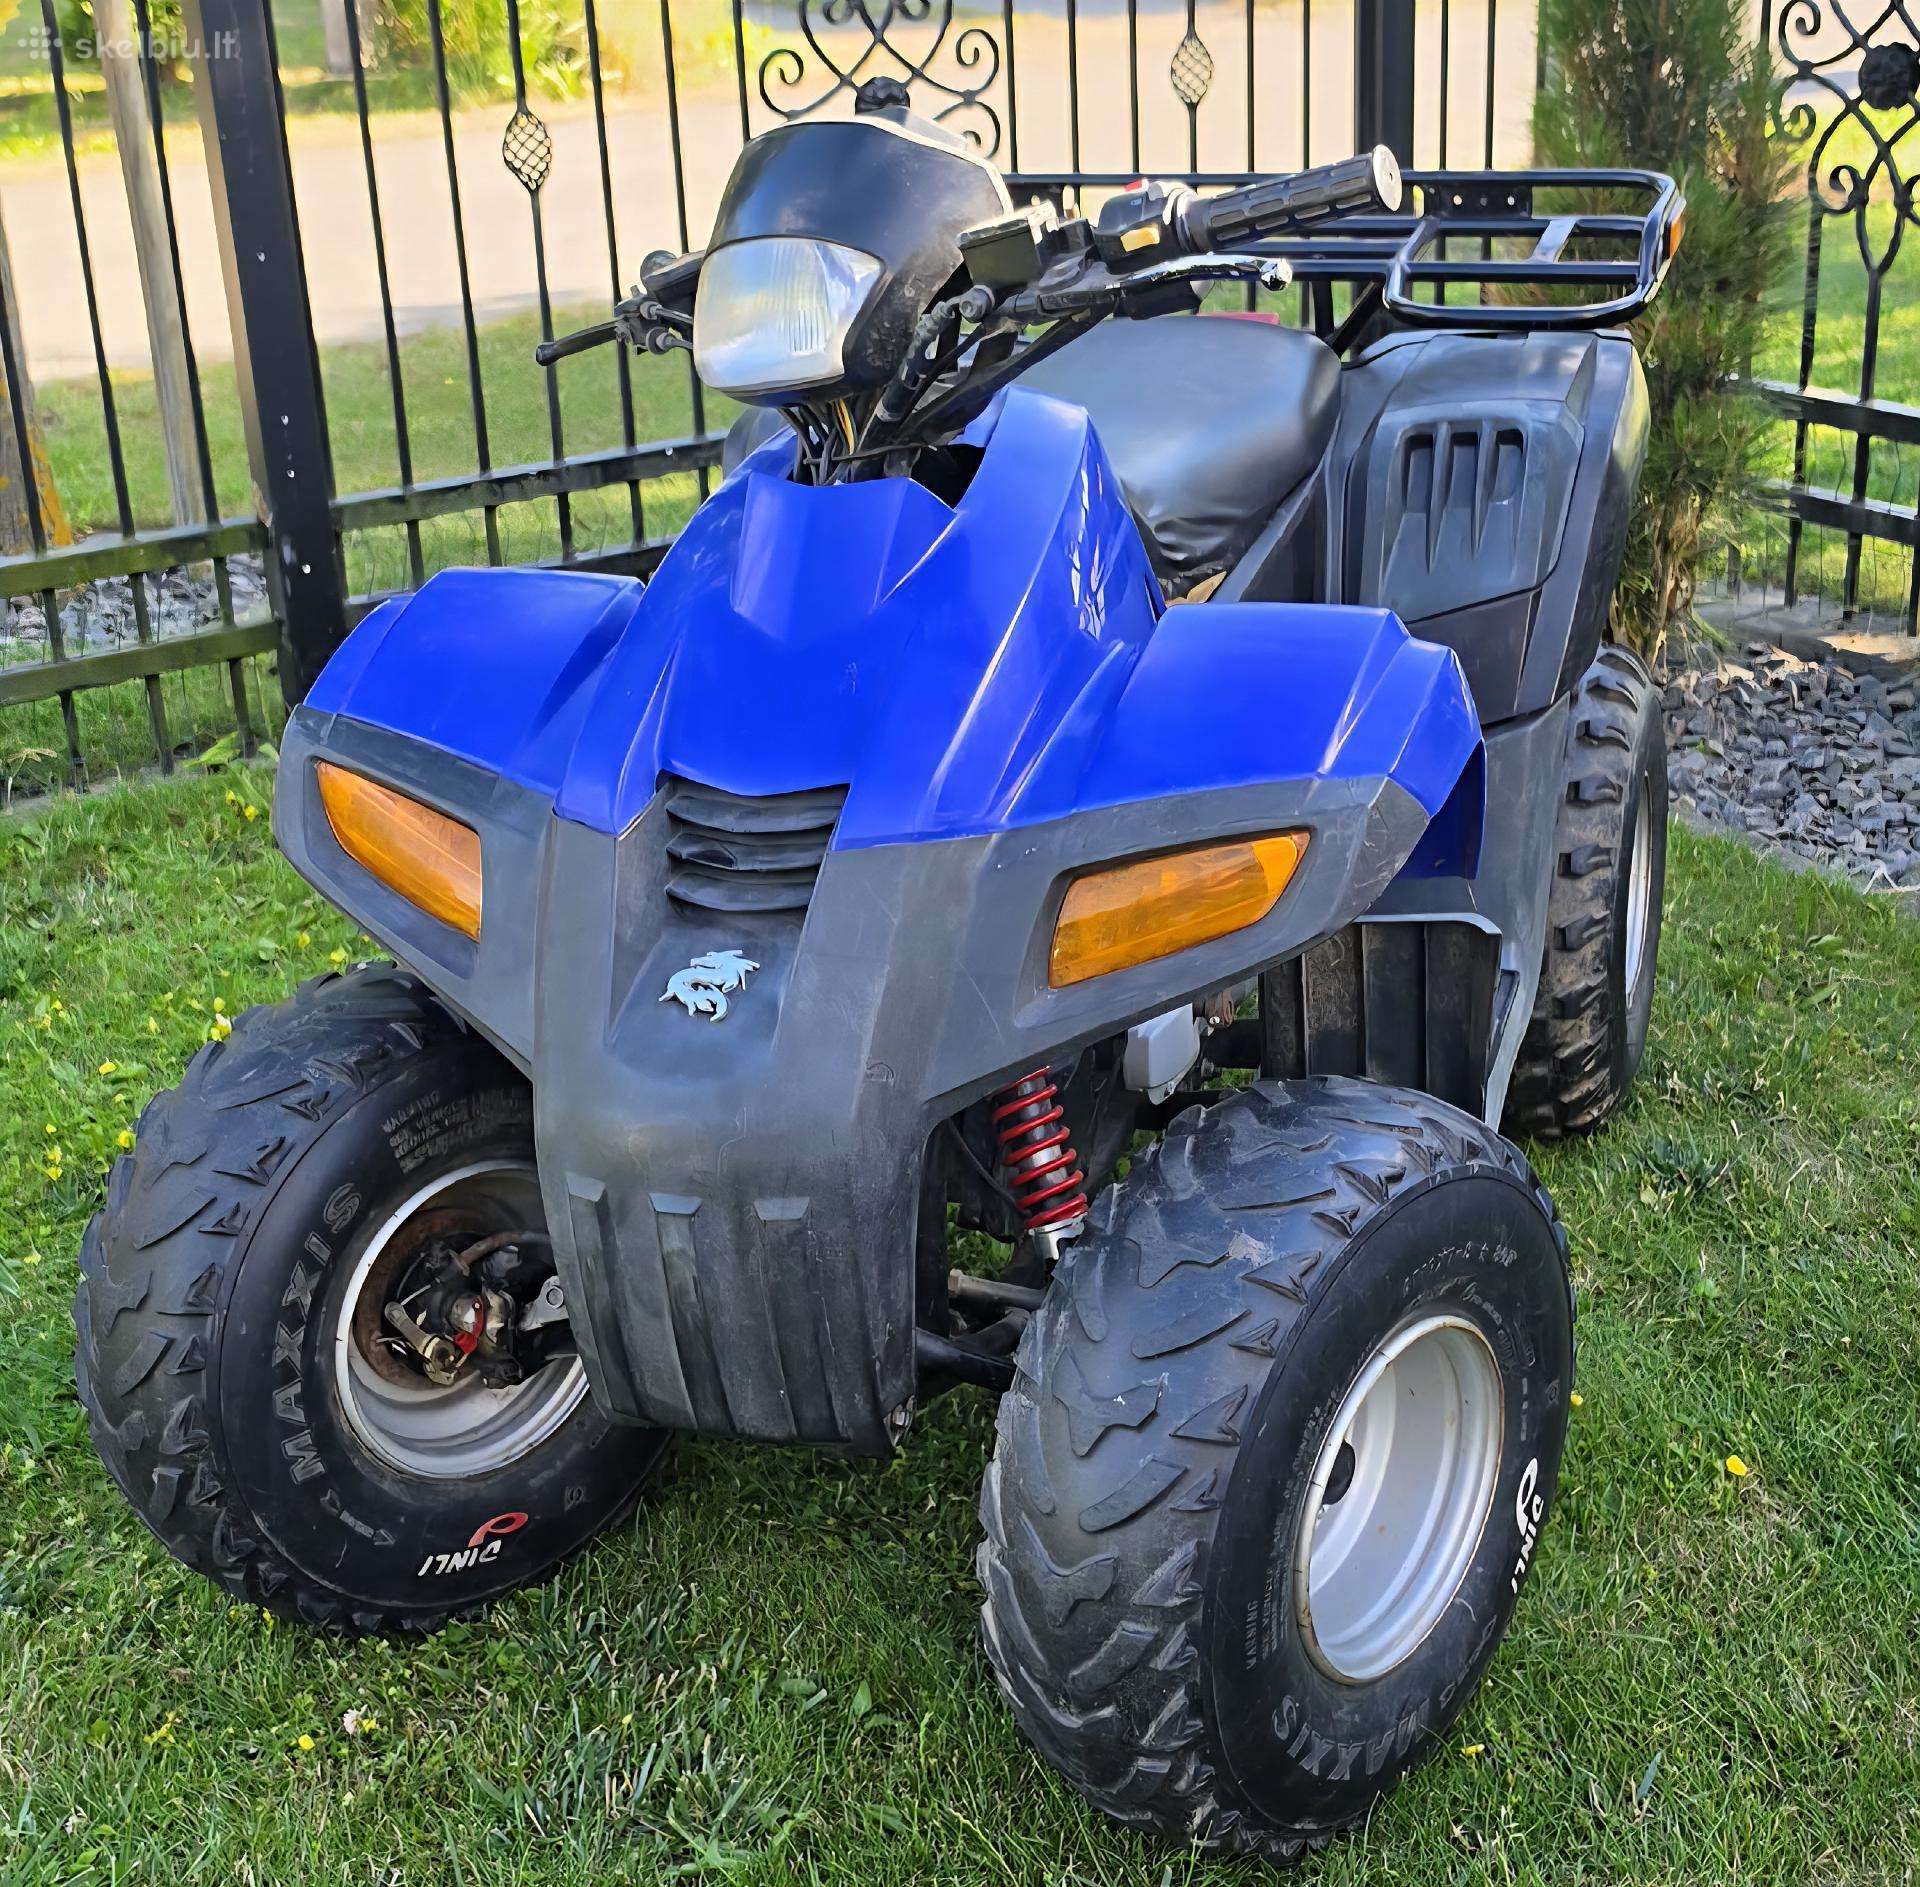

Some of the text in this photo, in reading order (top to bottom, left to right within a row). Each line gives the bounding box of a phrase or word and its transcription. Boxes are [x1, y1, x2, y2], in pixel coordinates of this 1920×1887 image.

[272, 1182, 362, 1485] MAXXIS
[418, 1539, 502, 1576] DINLI
[1511, 1494, 1544, 1594] DINLI
[1271, 1695, 1431, 1781] MAXXIS
